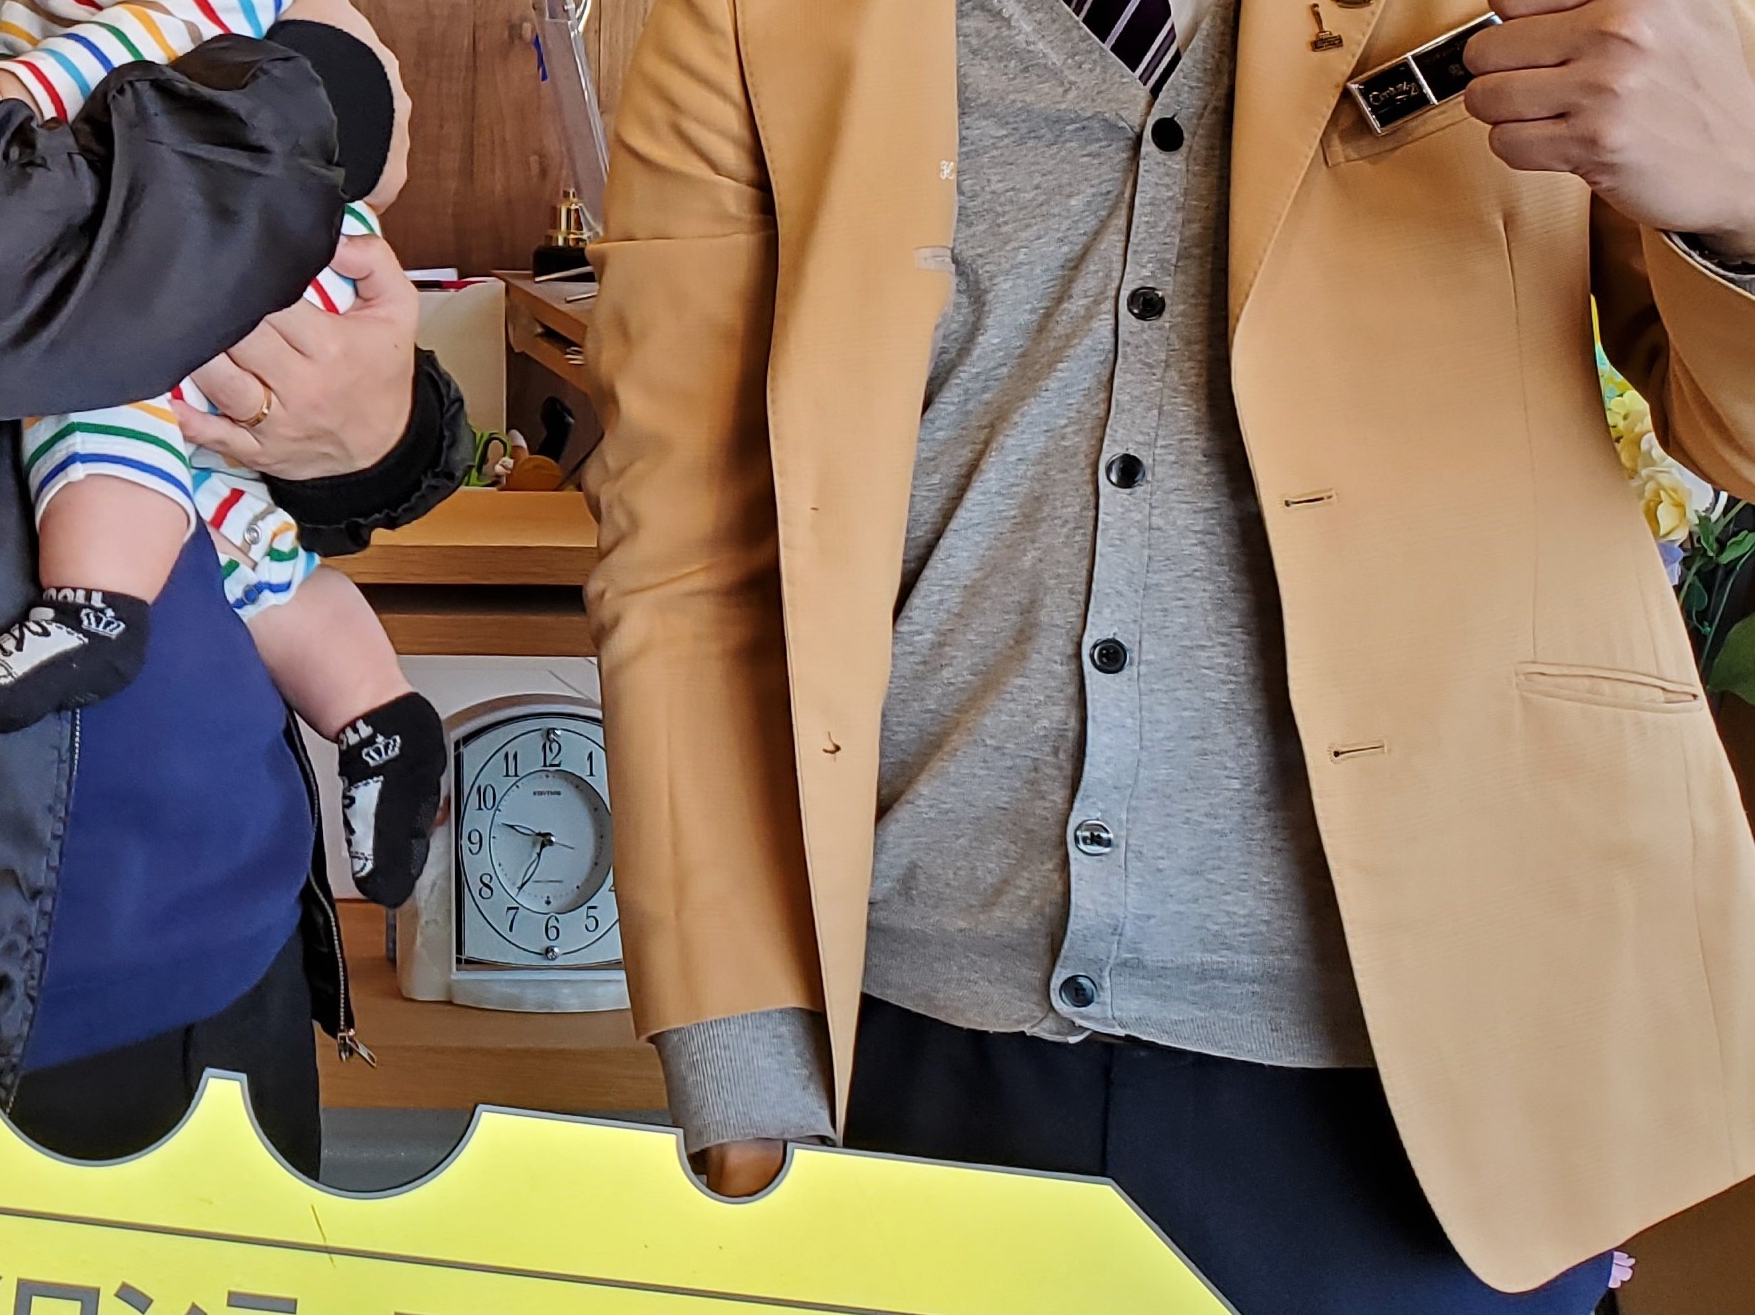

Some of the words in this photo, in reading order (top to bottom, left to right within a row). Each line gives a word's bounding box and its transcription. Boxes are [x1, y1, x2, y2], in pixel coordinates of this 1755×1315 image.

[502, 750, 520, 777] 11
[540, 738, 563, 768] 12
[586, 750, 596, 777] 1
[475, 783, 497, 811] 10
[467, 828, 483, 856] 9
[478, 872, 494, 900] 8
[505, 906, 520, 933] 7
[544, 914, 560, 942] 6
[584, 905, 599, 932] 5
